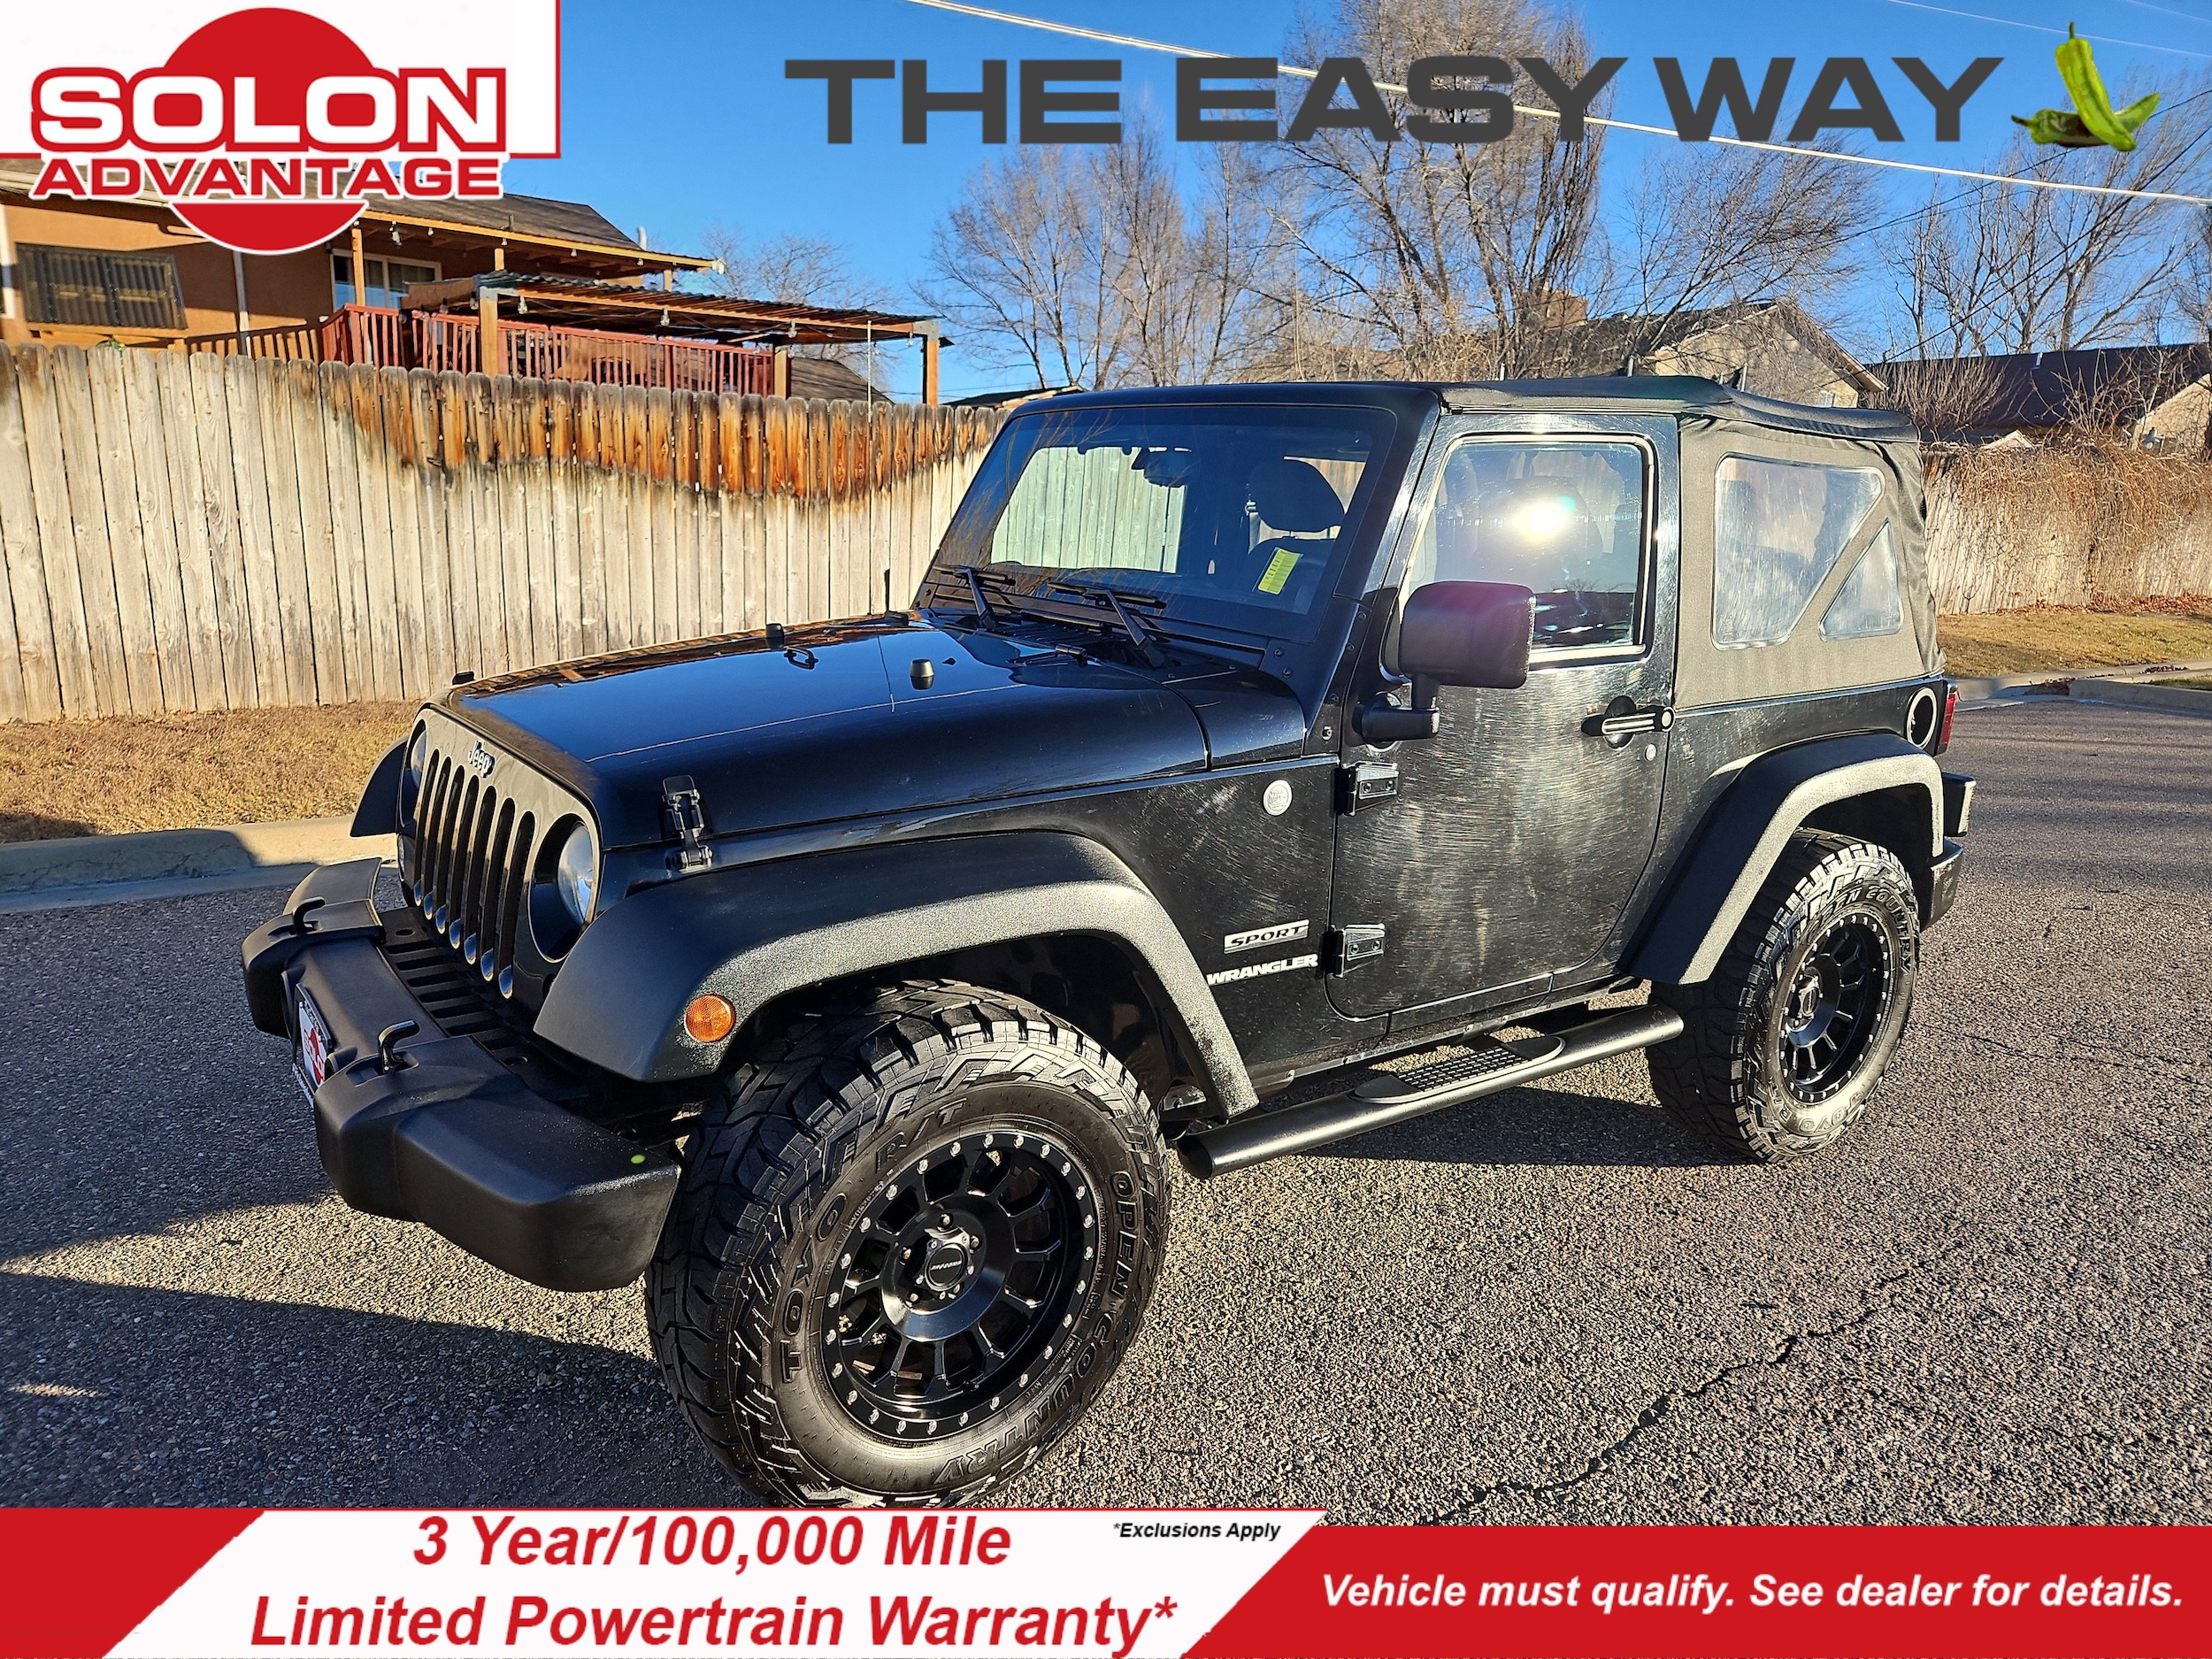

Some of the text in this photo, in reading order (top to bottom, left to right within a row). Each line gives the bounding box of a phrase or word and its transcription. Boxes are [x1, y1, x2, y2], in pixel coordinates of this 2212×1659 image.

[1206, 954, 1318, 986] WRANGLER
[1230, 926, 1302, 948] SPORT
[780, 1193, 847, 1384] TOYO
[1108, 1171, 1139, 1299] OPEN
[932, 1312, 1114, 1486] COUNTRY
